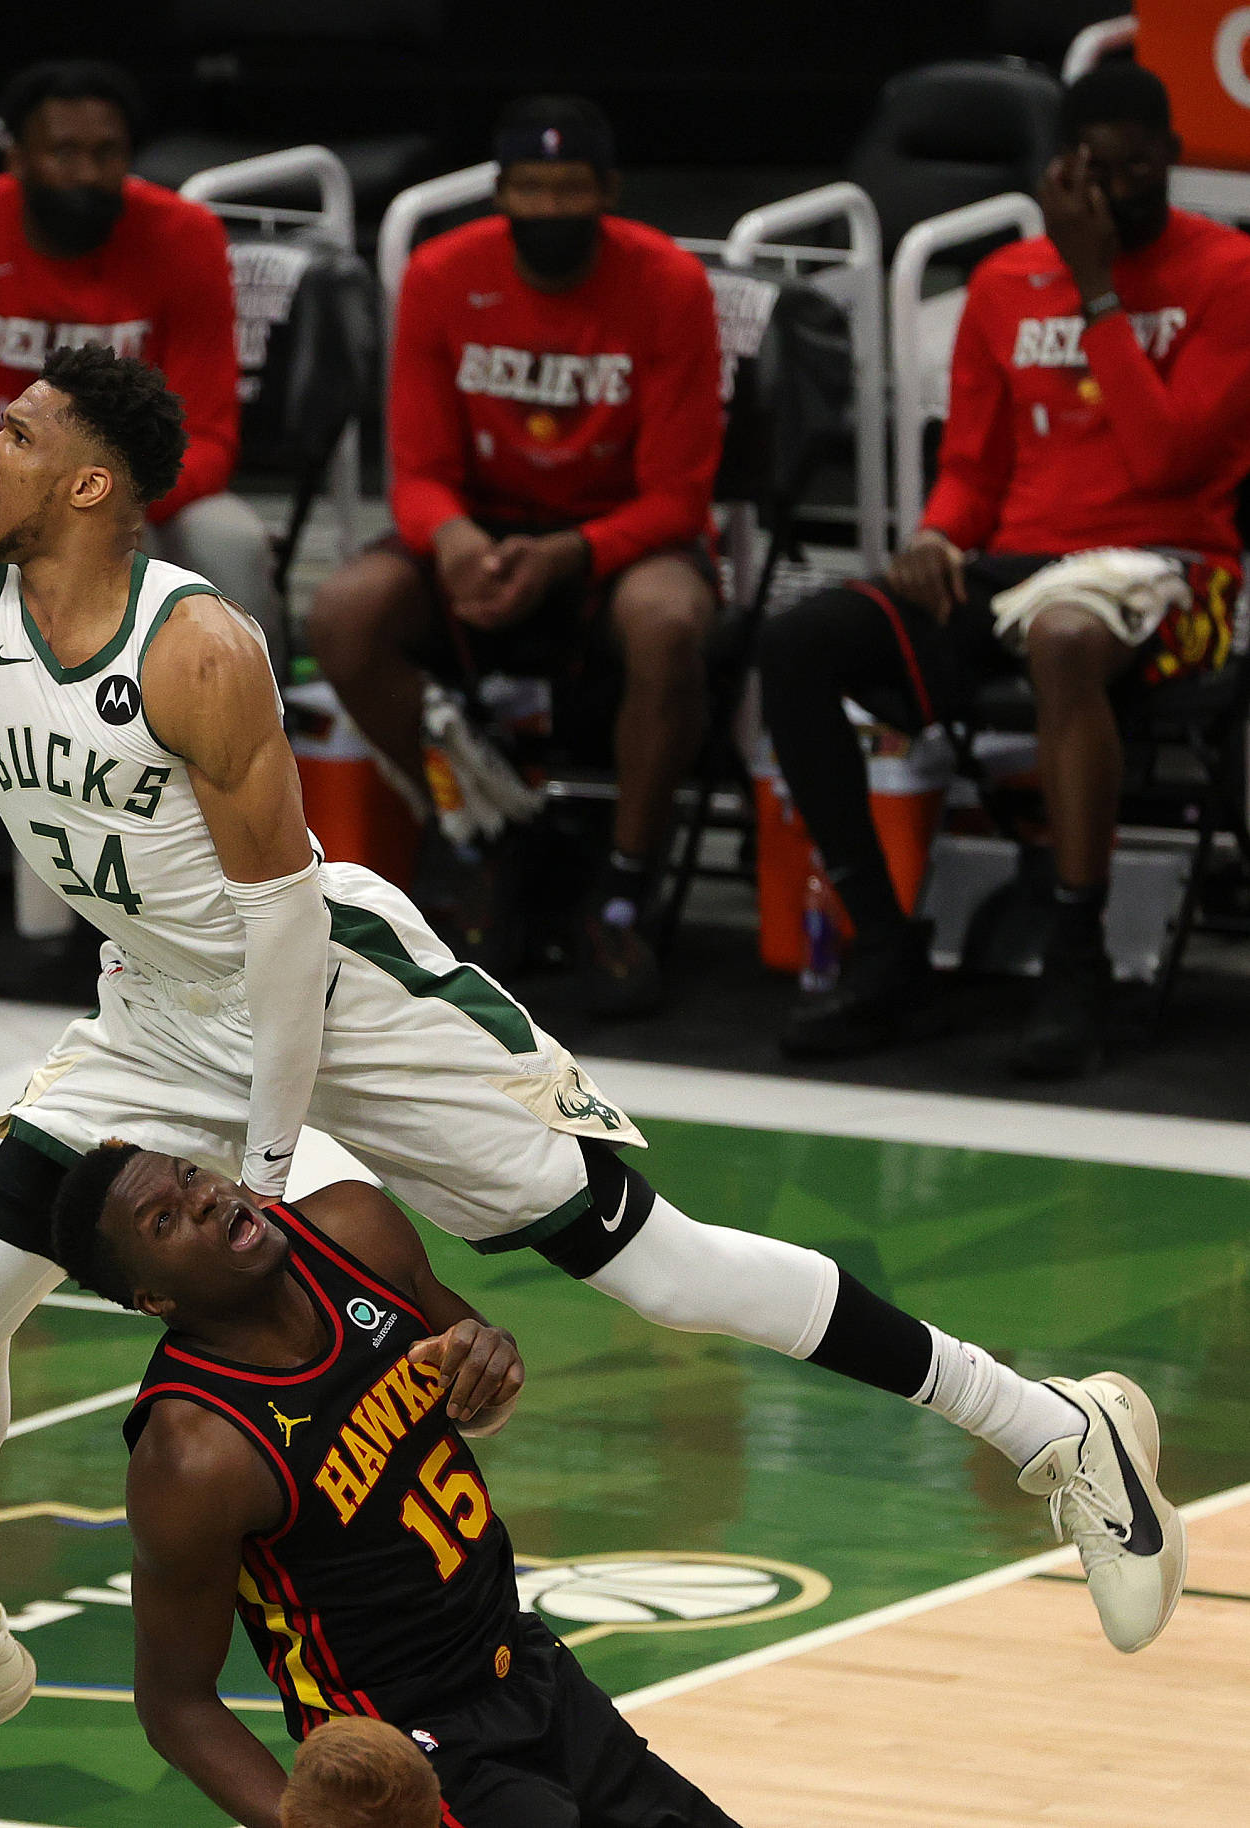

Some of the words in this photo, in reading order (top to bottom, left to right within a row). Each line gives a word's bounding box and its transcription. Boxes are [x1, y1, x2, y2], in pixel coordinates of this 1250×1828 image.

[456, 341, 633, 407] BELIEVE
[1012, 306, 1187, 369] BELVE
[29, 820, 143, 916] 34
[372, 1312, 398, 1349] sharecare
[313, 1354, 448, 1528] HAWKS
[399, 1435, 493, 1584] 15
